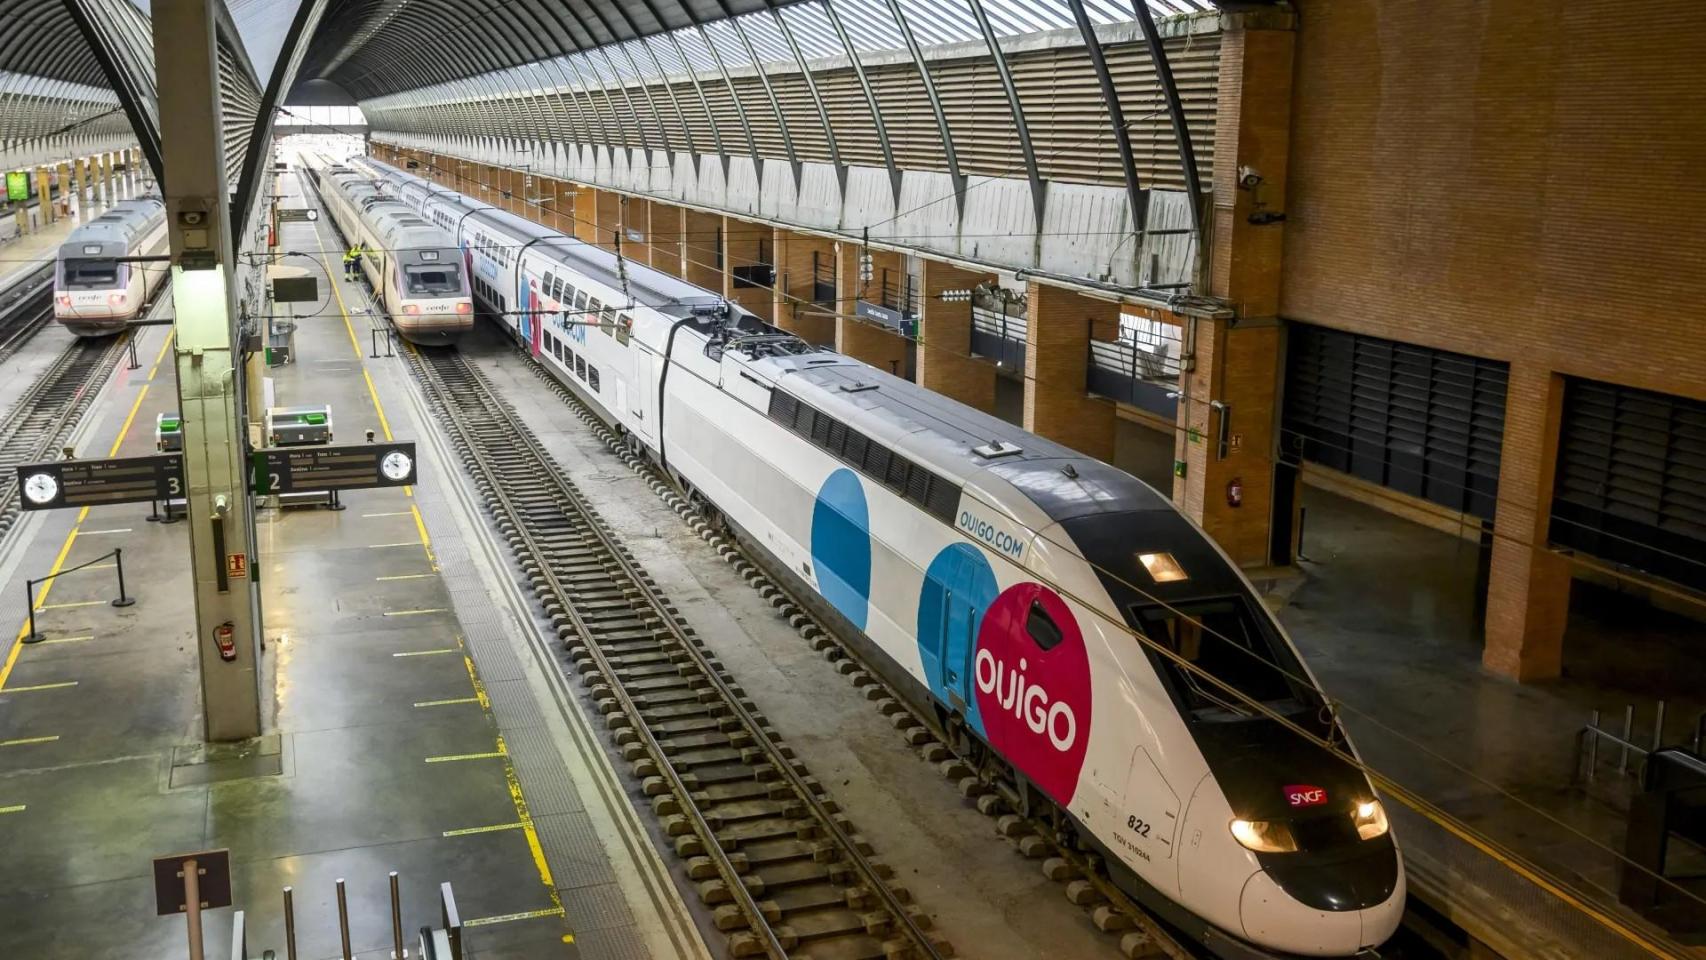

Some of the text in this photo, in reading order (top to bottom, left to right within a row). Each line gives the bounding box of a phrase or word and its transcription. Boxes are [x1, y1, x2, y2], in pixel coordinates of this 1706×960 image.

[167, 477, 181, 495] 3
[268, 473, 281, 490] 2
[960, 511, 1024, 559] OUIGO.COM
[1290, 789, 1323, 805] SNCF
[1127, 815, 1151, 839] 822
